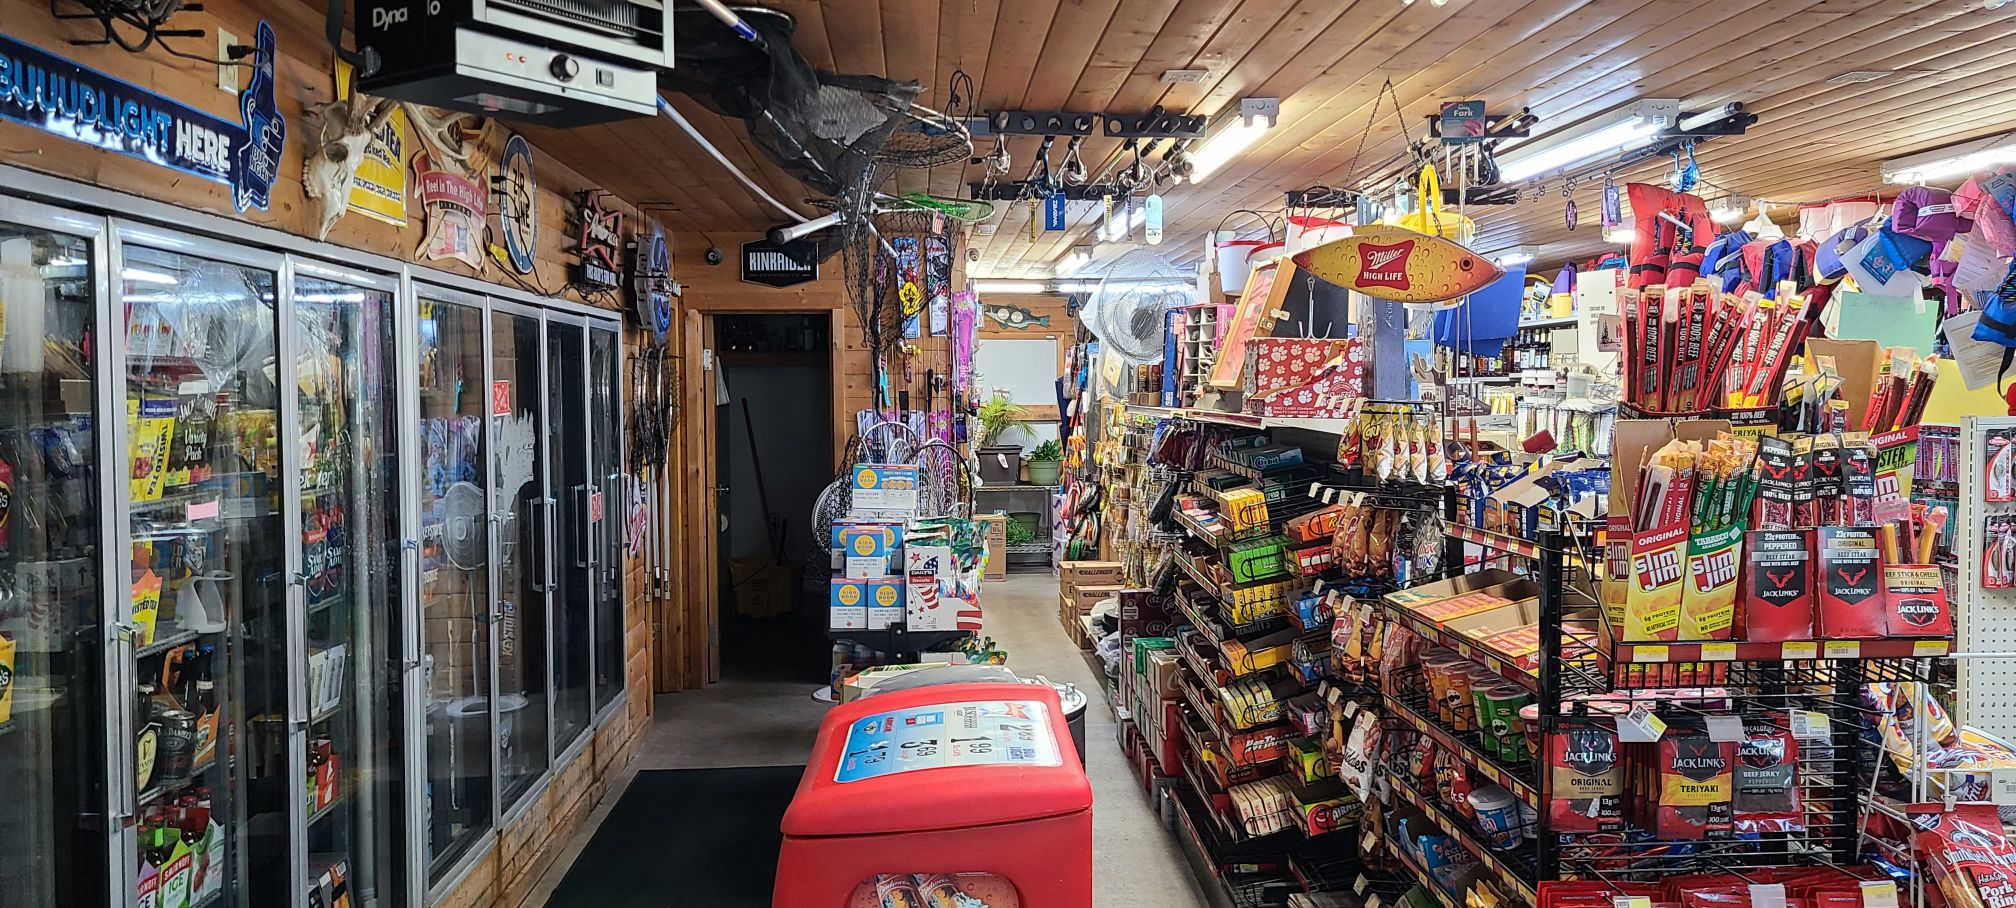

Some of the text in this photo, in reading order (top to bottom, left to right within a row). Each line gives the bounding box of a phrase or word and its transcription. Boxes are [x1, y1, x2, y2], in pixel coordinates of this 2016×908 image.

[1453, 108, 1474, 117] Fork
[175, 117, 231, 172] HERE
[425, 178, 439, 192] Reel
[439, 180, 446, 193] in
[446, 180, 458, 196] The
[458, 184, 473, 202] High
[1367, 248, 1405, 270] Miller
[1363, 271, 1403, 281] HIGH LIFE
[1740, 410, 1767, 420] 100% BEEF
[185, 429, 207, 448] Variety
[185, 447, 202, 463] Pack
[1608, 524, 1632, 532] ORIGINAL
[1638, 527, 1685, 547] ORIGINAL
[1694, 531, 1729, 546] TABASCO
[1764, 533, 1775, 541] 23g
[1835, 530, 1846, 538] 23g
[1763, 542, 1797, 550] PEPPERED
[1761, 590, 1778, 598] JACK
[1834, 588, 1851, 596] JACK
[1707, 609, 1730, 620] PROTEIN
[1896, 605, 1917, 614] JACK
[1643, 609, 1676, 622] 6g PROTEIN
[1700, 624, 1708, 632] NO
[1009, 746, 1024, 761] LIGHT
[1022, 747, 1036, 759] BUD
[1563, 751, 1587, 762] JACK
[1735, 747, 1758, 757] JACK
[1671, 757, 1697, 769] JACK
[1760, 770, 1780, 778] JERKY
[1570, 778, 1612, 786] ORIGINAL
[1680, 785, 1719, 793] TERIYAKI
[1602, 798, 1613, 806] 13g
[1710, 804, 1721, 812] 13g
[164, 852, 192, 882] SMIRNOFF
[168, 873, 185, 892] ICE
[1979, 881, 2014, 900] Pork
